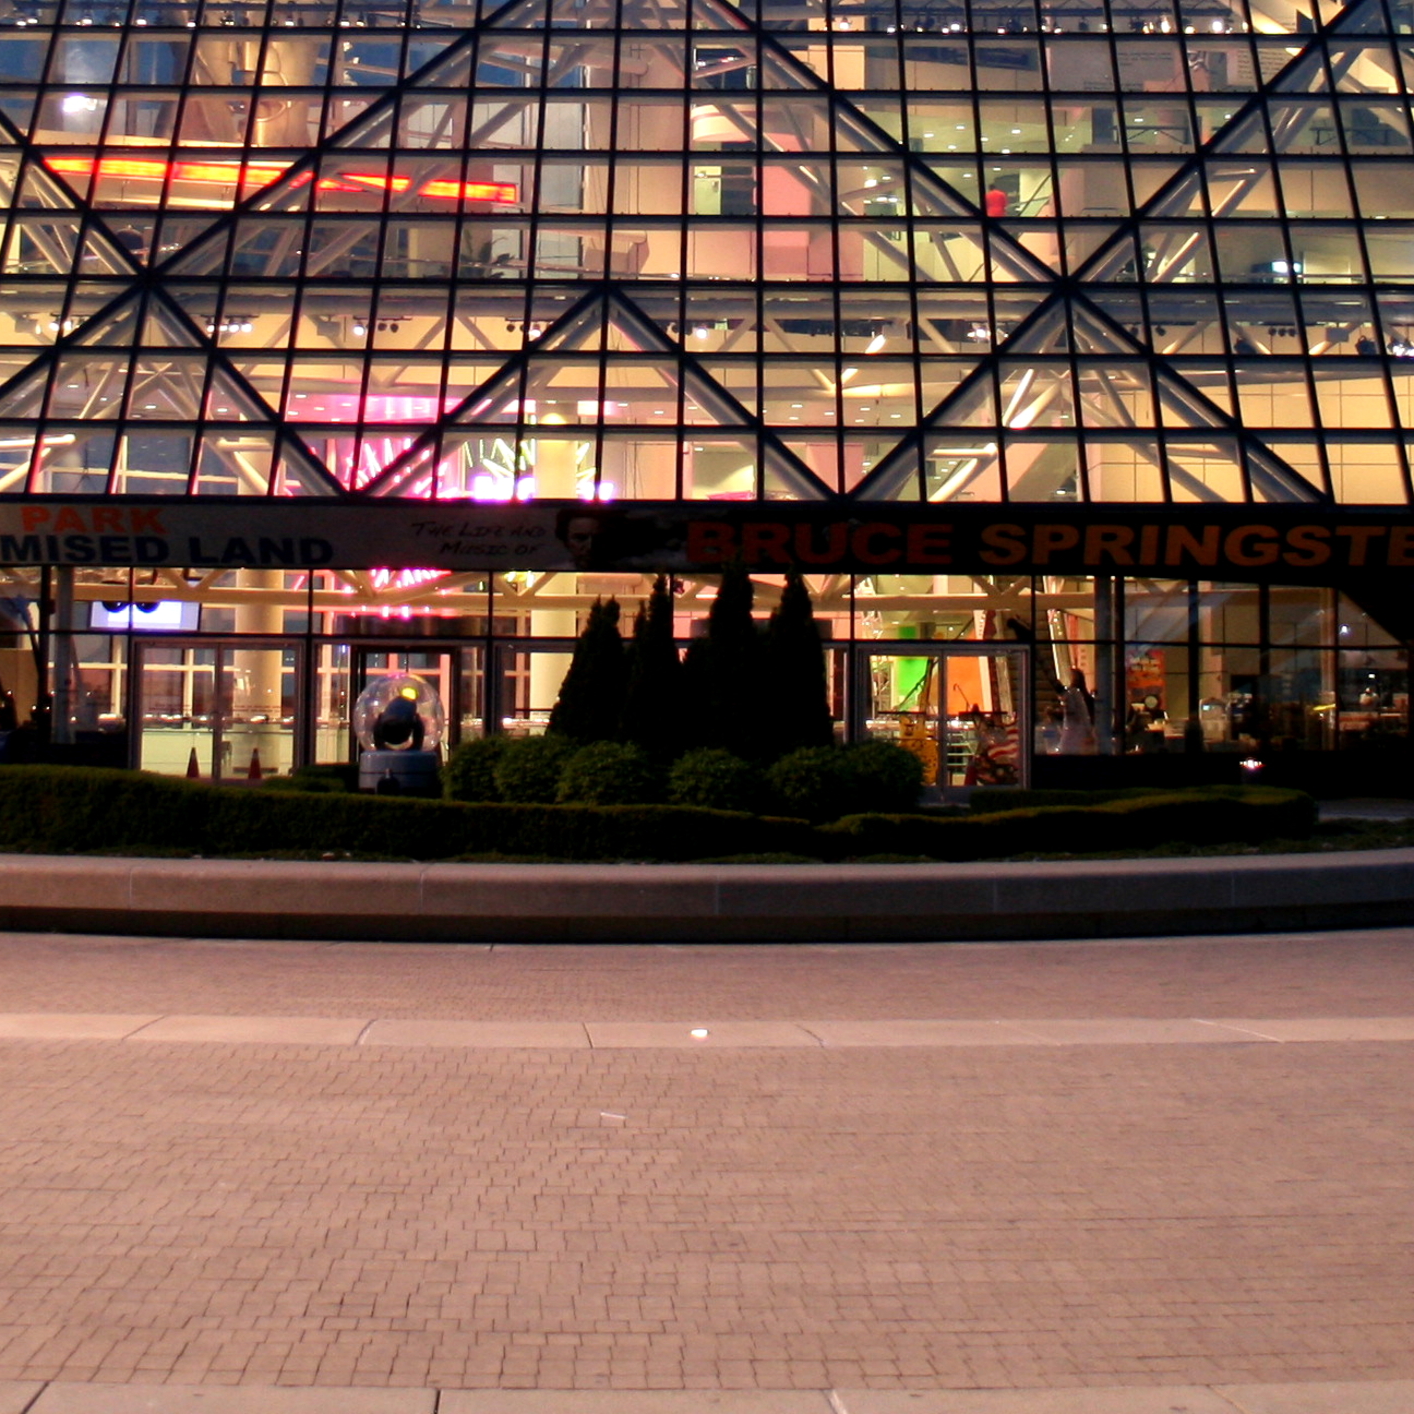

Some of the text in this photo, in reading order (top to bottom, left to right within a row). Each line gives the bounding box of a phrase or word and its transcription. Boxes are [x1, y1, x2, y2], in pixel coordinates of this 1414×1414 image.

[20, 504, 169, 535] PARK
[188, 535, 336, 566] LAND
[685, 519, 955, 566] BRUCE
